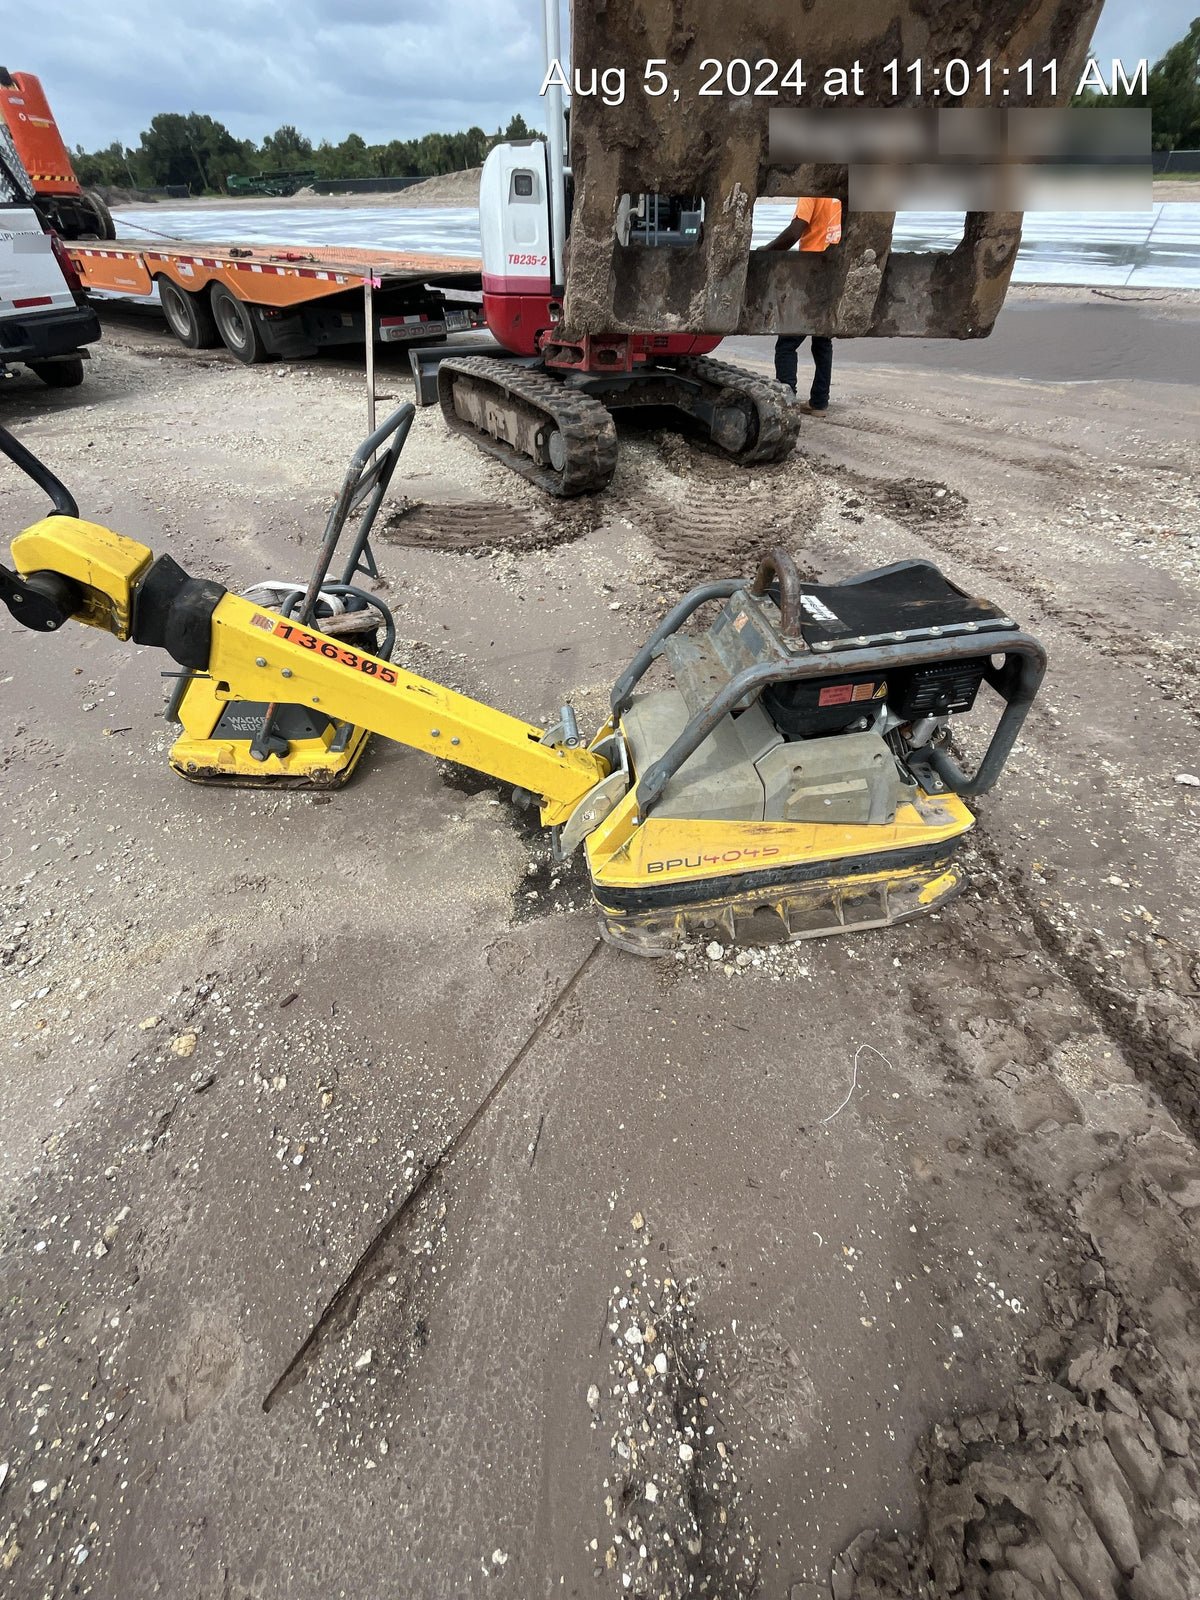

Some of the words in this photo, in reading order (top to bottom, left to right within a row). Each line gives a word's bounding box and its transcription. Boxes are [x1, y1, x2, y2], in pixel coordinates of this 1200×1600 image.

[508, 254, 547, 266] TB235-2
[280, 625, 396, 684] 136305
[226, 716, 267, 725] WACKE
[231, 722, 281, 732] NEUSN
[647, 847, 779, 873] BPU4045
